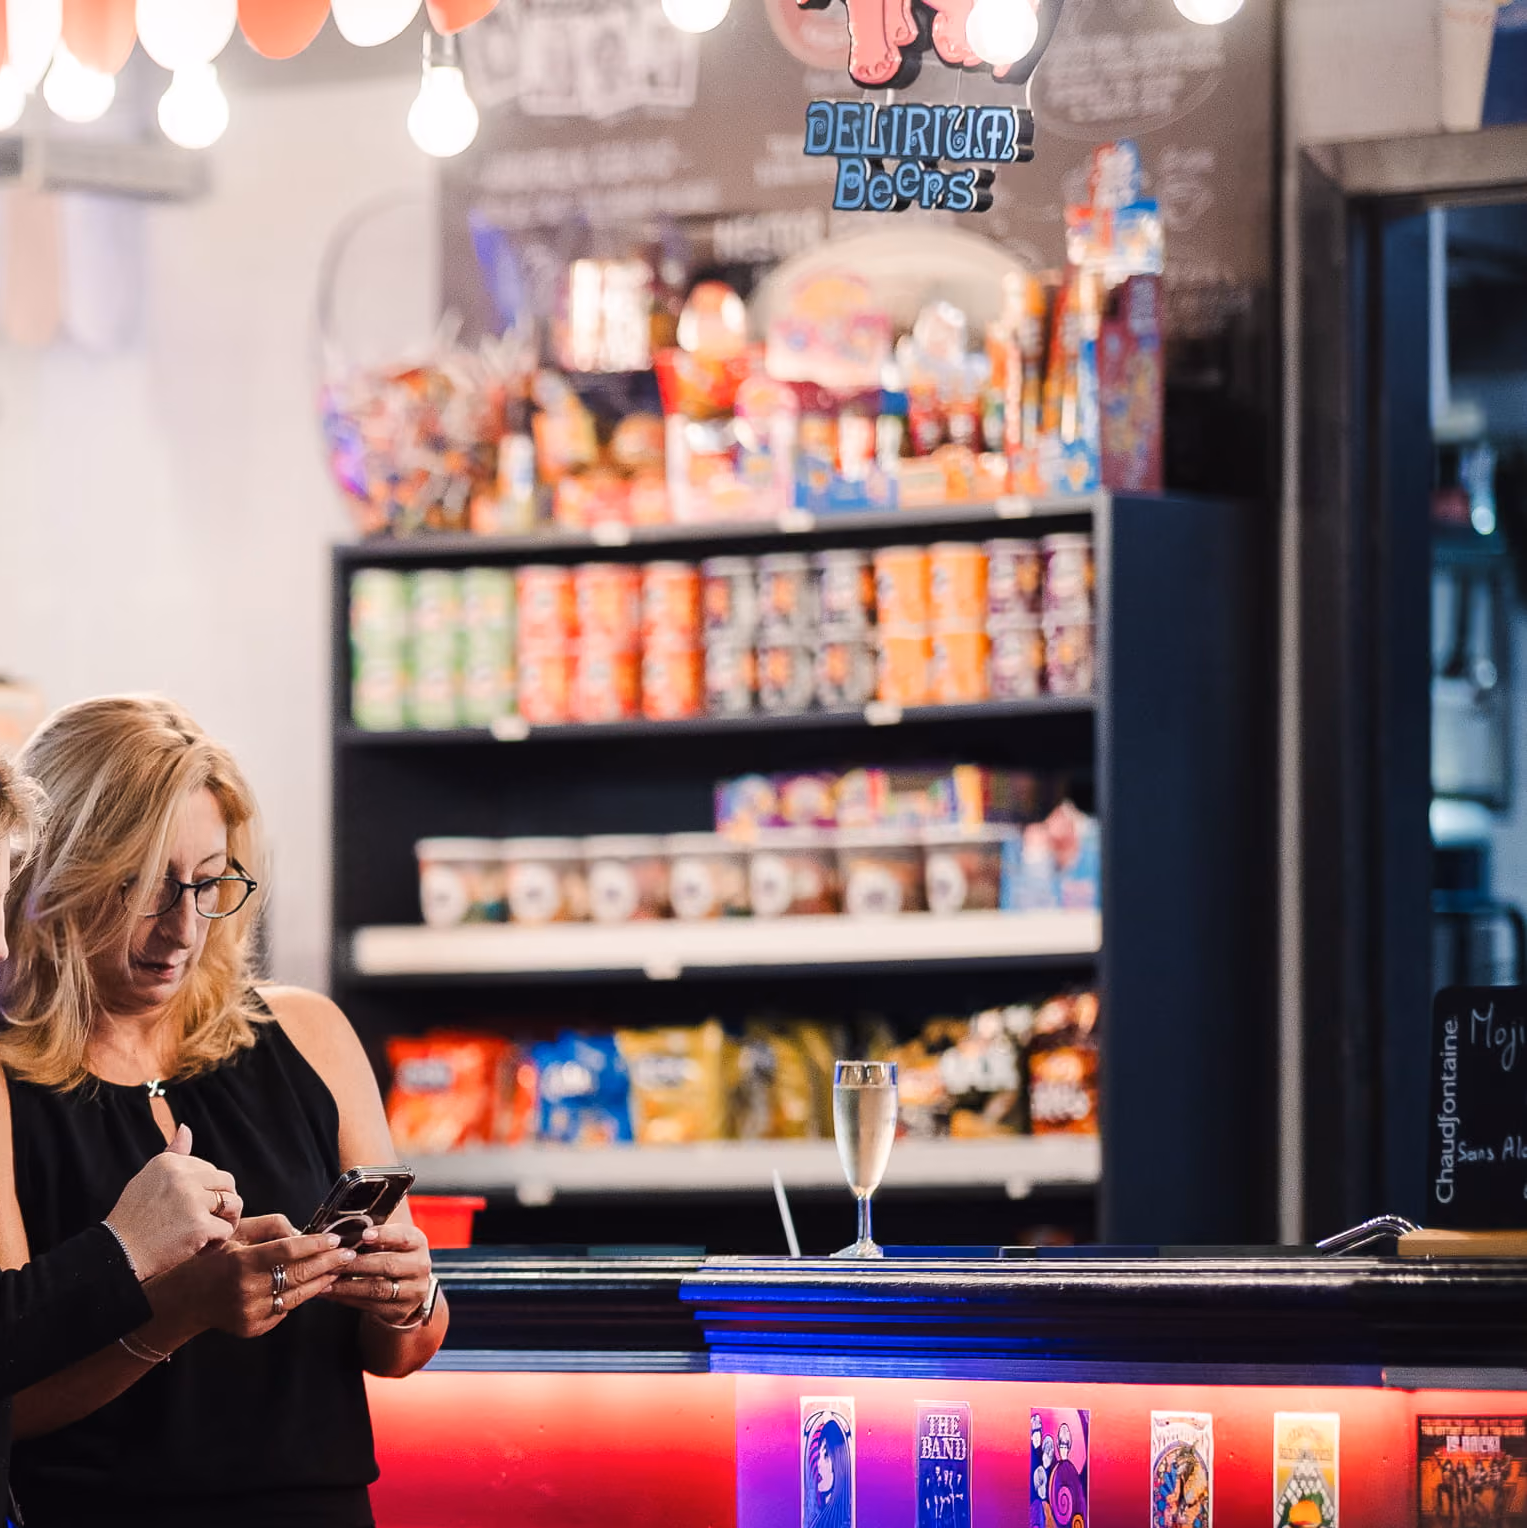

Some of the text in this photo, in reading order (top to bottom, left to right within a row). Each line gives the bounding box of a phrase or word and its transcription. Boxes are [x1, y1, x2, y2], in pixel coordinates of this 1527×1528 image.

[805, 101, 1015, 160] DELIRIUM
[835, 157, 975, 210] Beers
[1435, 1017, 1460, 1204] Chaudfontaine
[920, 1437, 967, 1460] BAND
[927, 1414, 961, 1437] THE
